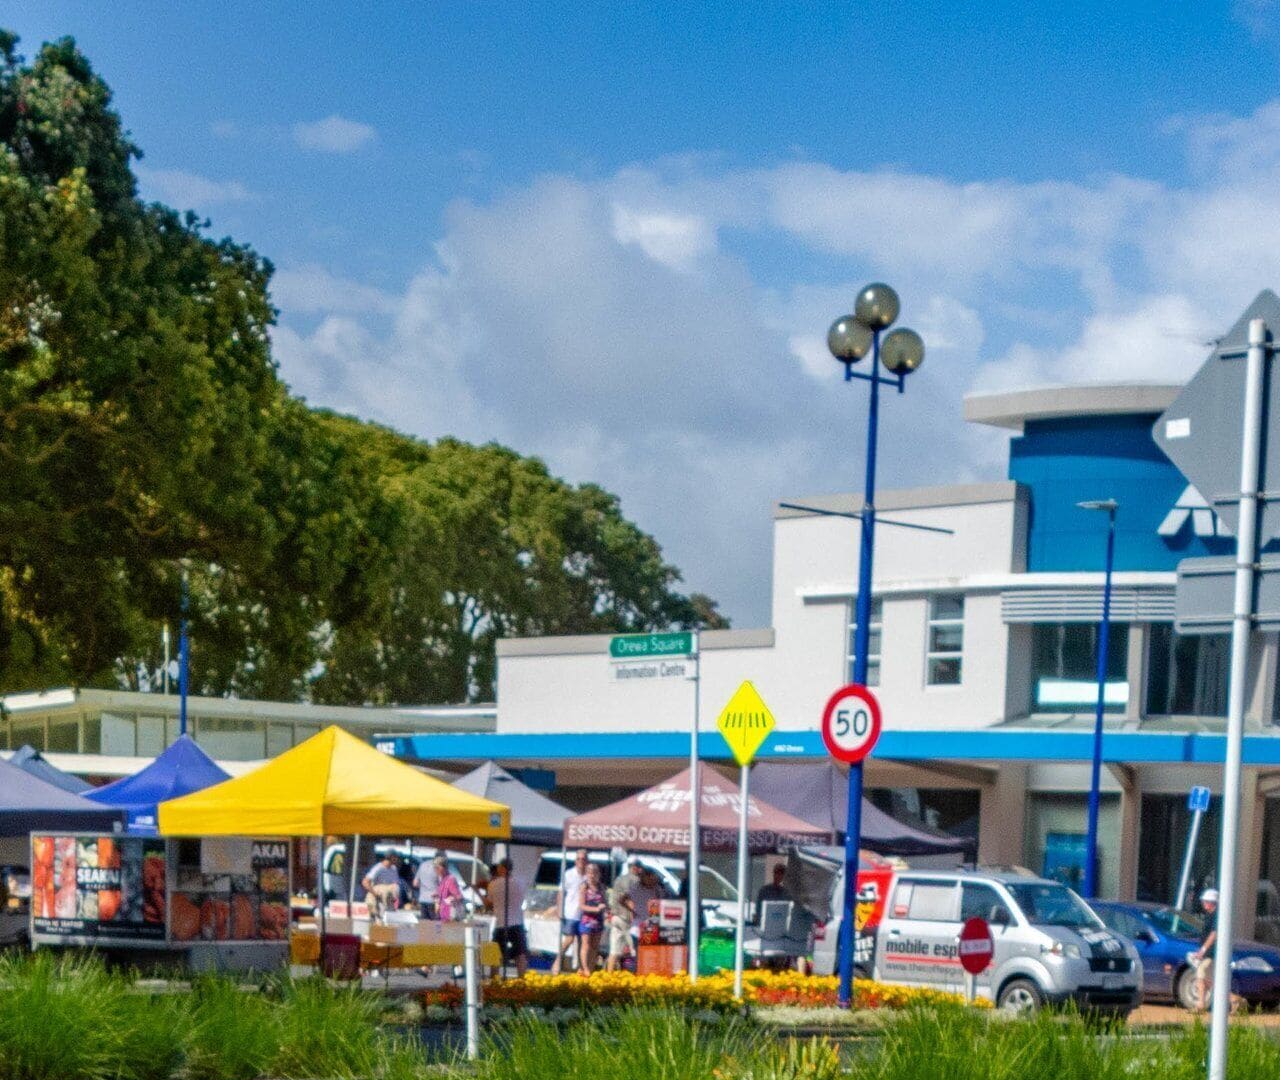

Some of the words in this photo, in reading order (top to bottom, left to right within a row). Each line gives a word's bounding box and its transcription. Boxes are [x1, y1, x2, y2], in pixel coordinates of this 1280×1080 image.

[618, 639, 648, 653] Orewa
[650, 636, 685, 652] Square
[616, 665, 658, 679] Information
[661, 662, 686, 677] Centre
[836, 709, 868, 736] 50
[569, 824, 638, 841] ESPRESSO
[639, 827, 690, 845] COFFEE
[703, 829, 772, 847] ESPRSSO
[77, 868, 120, 883] SEAKAI
[886, 938, 930, 955] mobile
